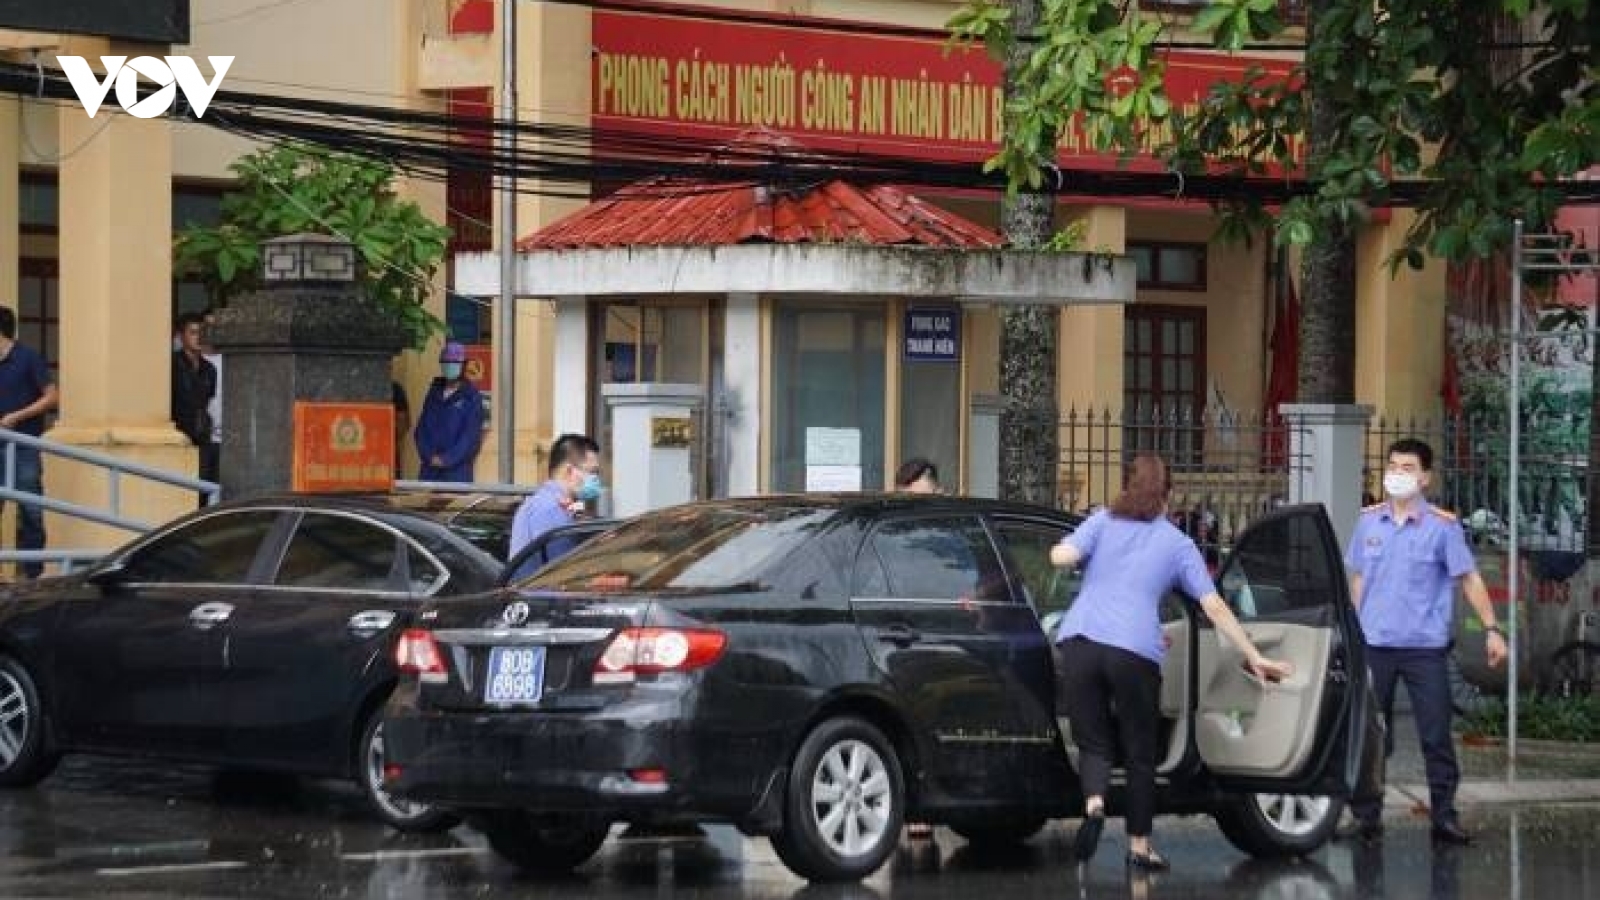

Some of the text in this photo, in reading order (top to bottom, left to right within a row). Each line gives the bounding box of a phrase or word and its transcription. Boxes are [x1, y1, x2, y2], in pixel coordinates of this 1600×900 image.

[599, 52, 670, 119] PHONG
[676, 46, 730, 123] CÁCH
[735, 51, 797, 129] NGƯỜI
[801, 58, 854, 133] CÔNG
[858, 73, 886, 136] AN
[891, 68, 944, 140] NHÂN
[948, 71, 986, 143] DÂN
[500, 650, 534, 673] 80B
